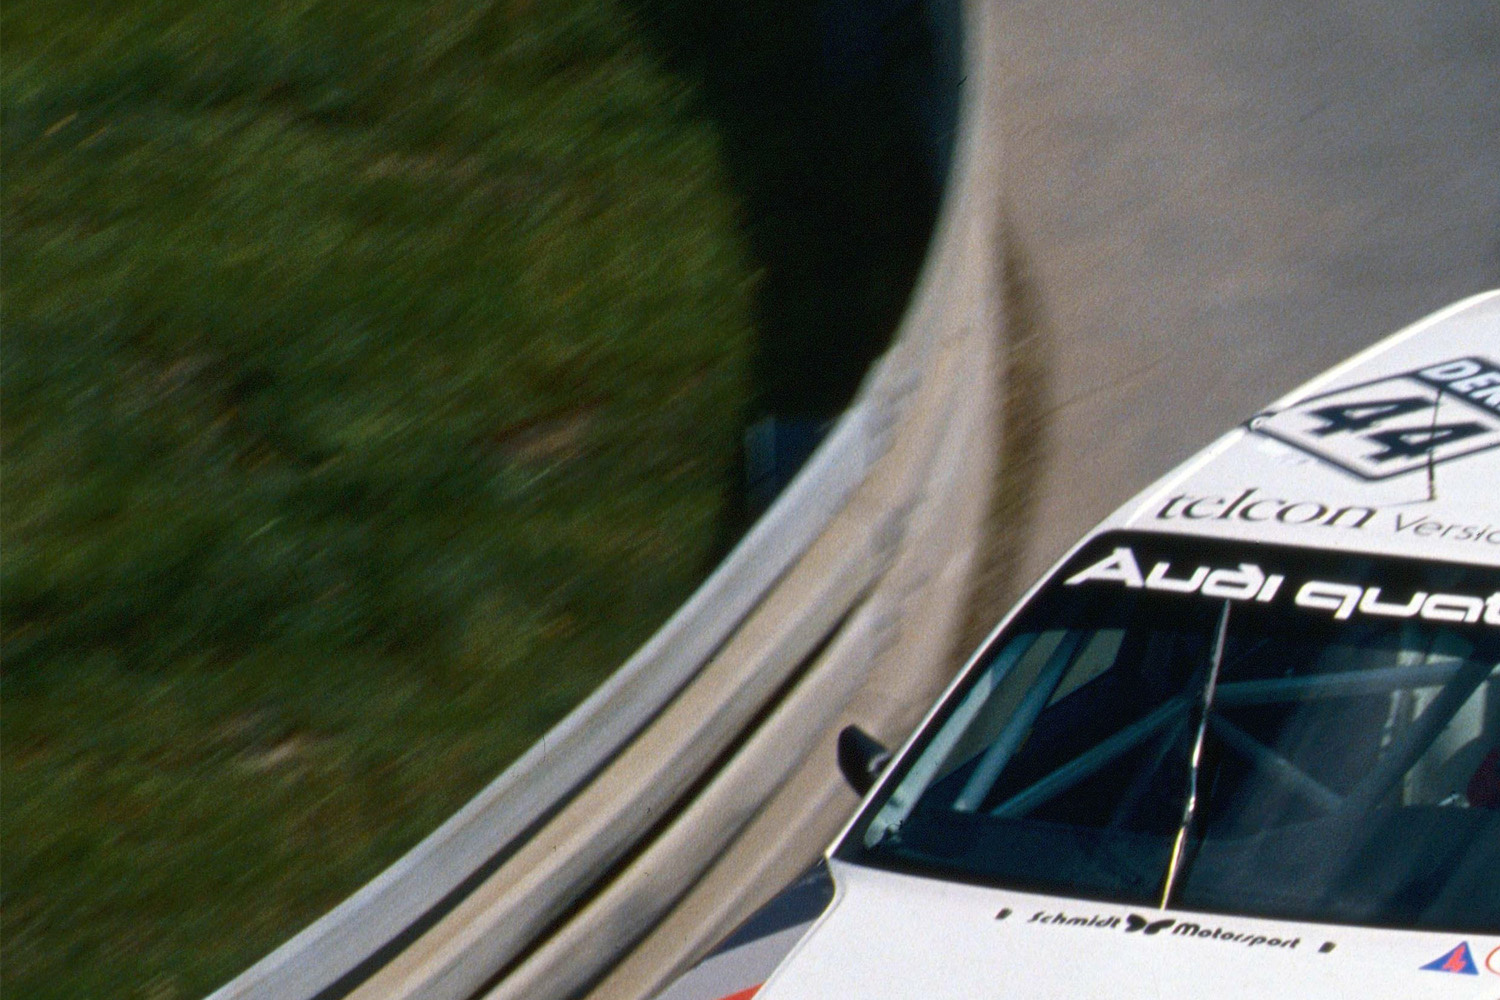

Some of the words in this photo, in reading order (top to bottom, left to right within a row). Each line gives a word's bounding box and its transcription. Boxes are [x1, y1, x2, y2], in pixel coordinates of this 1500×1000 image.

[1308, 397, 1491, 464] 44
[1156, 486, 1377, 531] telcon
[1064, 547, 1286, 602] Audi
[1027, 911, 1121, 929] Schmidt
[1172, 922, 1301, 949] Motorsport
